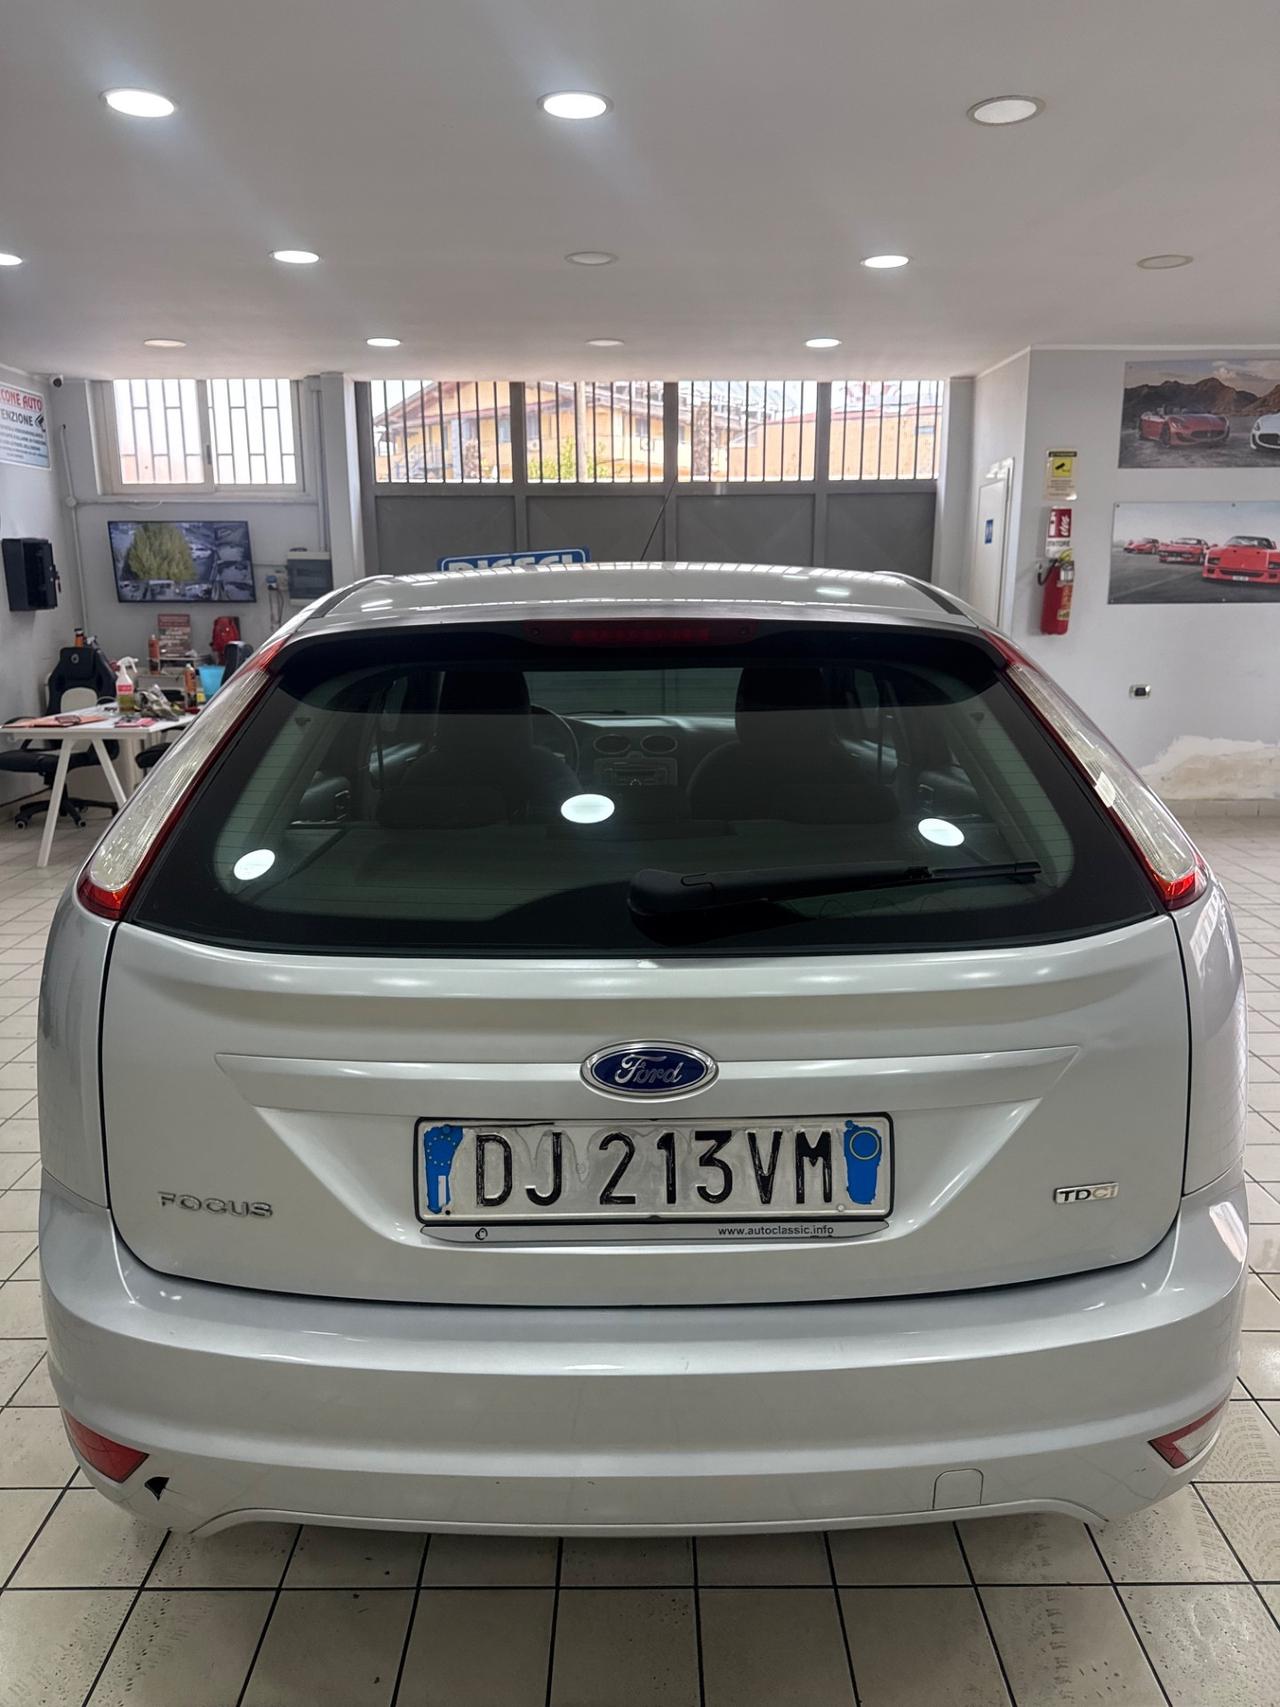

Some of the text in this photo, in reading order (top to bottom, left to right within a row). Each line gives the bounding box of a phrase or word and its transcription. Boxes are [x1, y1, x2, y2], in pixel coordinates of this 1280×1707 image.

[0, 388, 43, 412] CONE AUTO
[0, 408, 33, 427] ENZIONE
[614, 1054, 683, 1084] Ford
[158, 1191, 273, 1219] FOCUS
[718, 1225, 834, 1236] www.autoclassic.info
